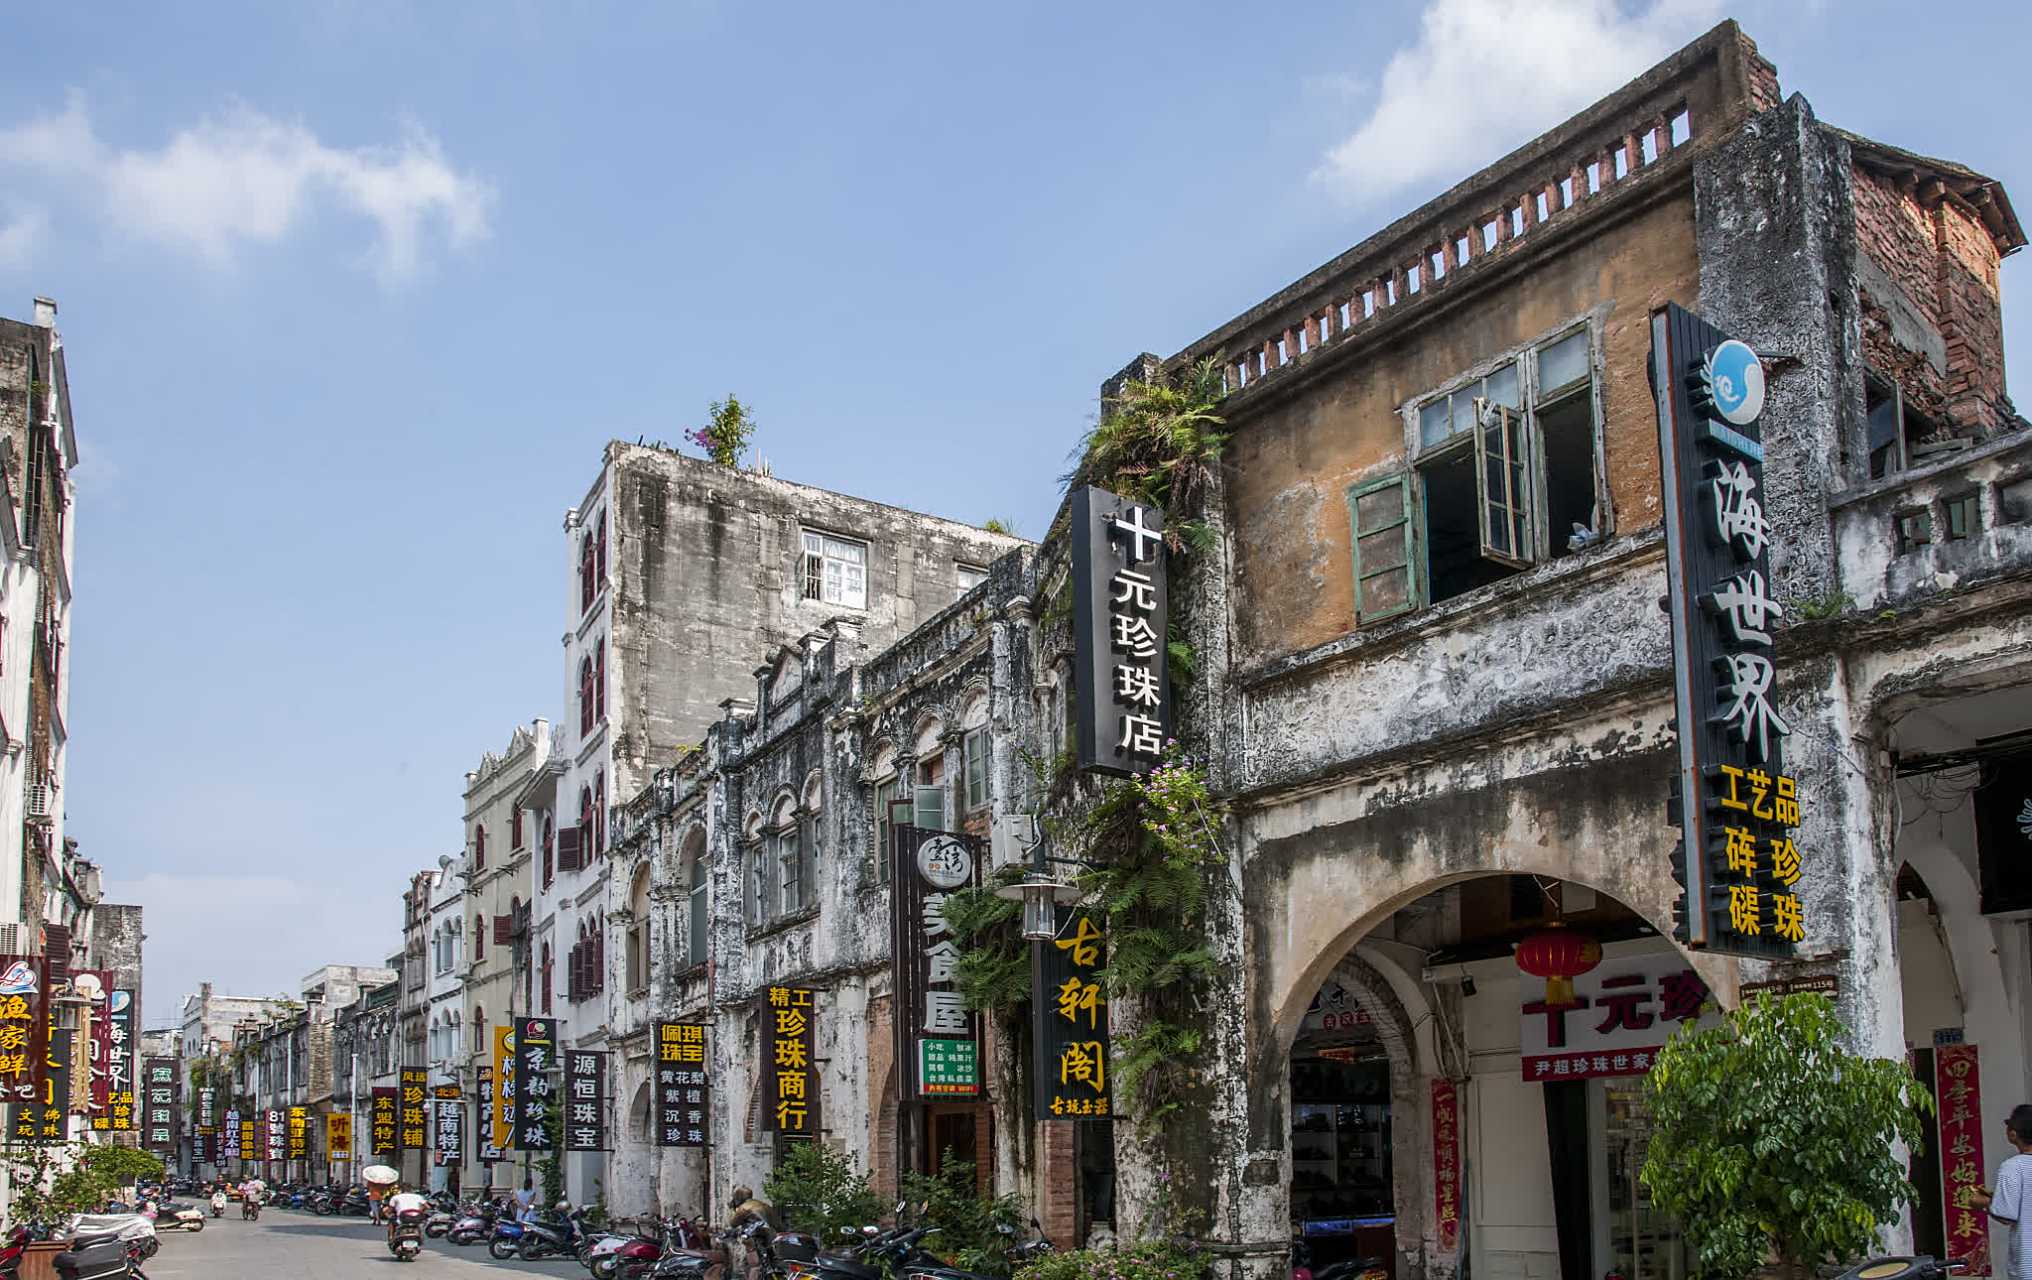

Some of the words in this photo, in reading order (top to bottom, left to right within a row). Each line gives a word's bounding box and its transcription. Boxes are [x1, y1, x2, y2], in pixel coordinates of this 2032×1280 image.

[1114, 506, 1162, 755] 十元珍珠店
[1713, 458, 1789, 763] 海世界
[1720, 763, 1801, 828] 工艺品
[1770, 834, 1805, 943] 珍珠
[769, 987, 811, 1007] 精工
[660, 1070, 705, 1085] 黄花梨
[662, 1043, 703, 1062] 珠宝
[776, 1008, 807, 1130] 珍珠商行
[1536, 1053, 1658, 1077] 尹超珍珠世家
[107, 1092, 133, 1104] 艺品
[402, 1087, 424, 1146] 珍珠铺
[523, 1047, 550, 1146] 京韵珍珠
[574, 1055, 597, 1147] 源恒珠宝
[665, 1089, 701, 1103] 紫檀
[665, 1110, 702, 1124] 沉香
[225, 1110, 239, 1148] 越南红木
[374, 1097, 395, 1155] 东盟特产
[439, 1102, 460, 1165] 越南特产
[666, 1129, 702, 1142] 珍珠
